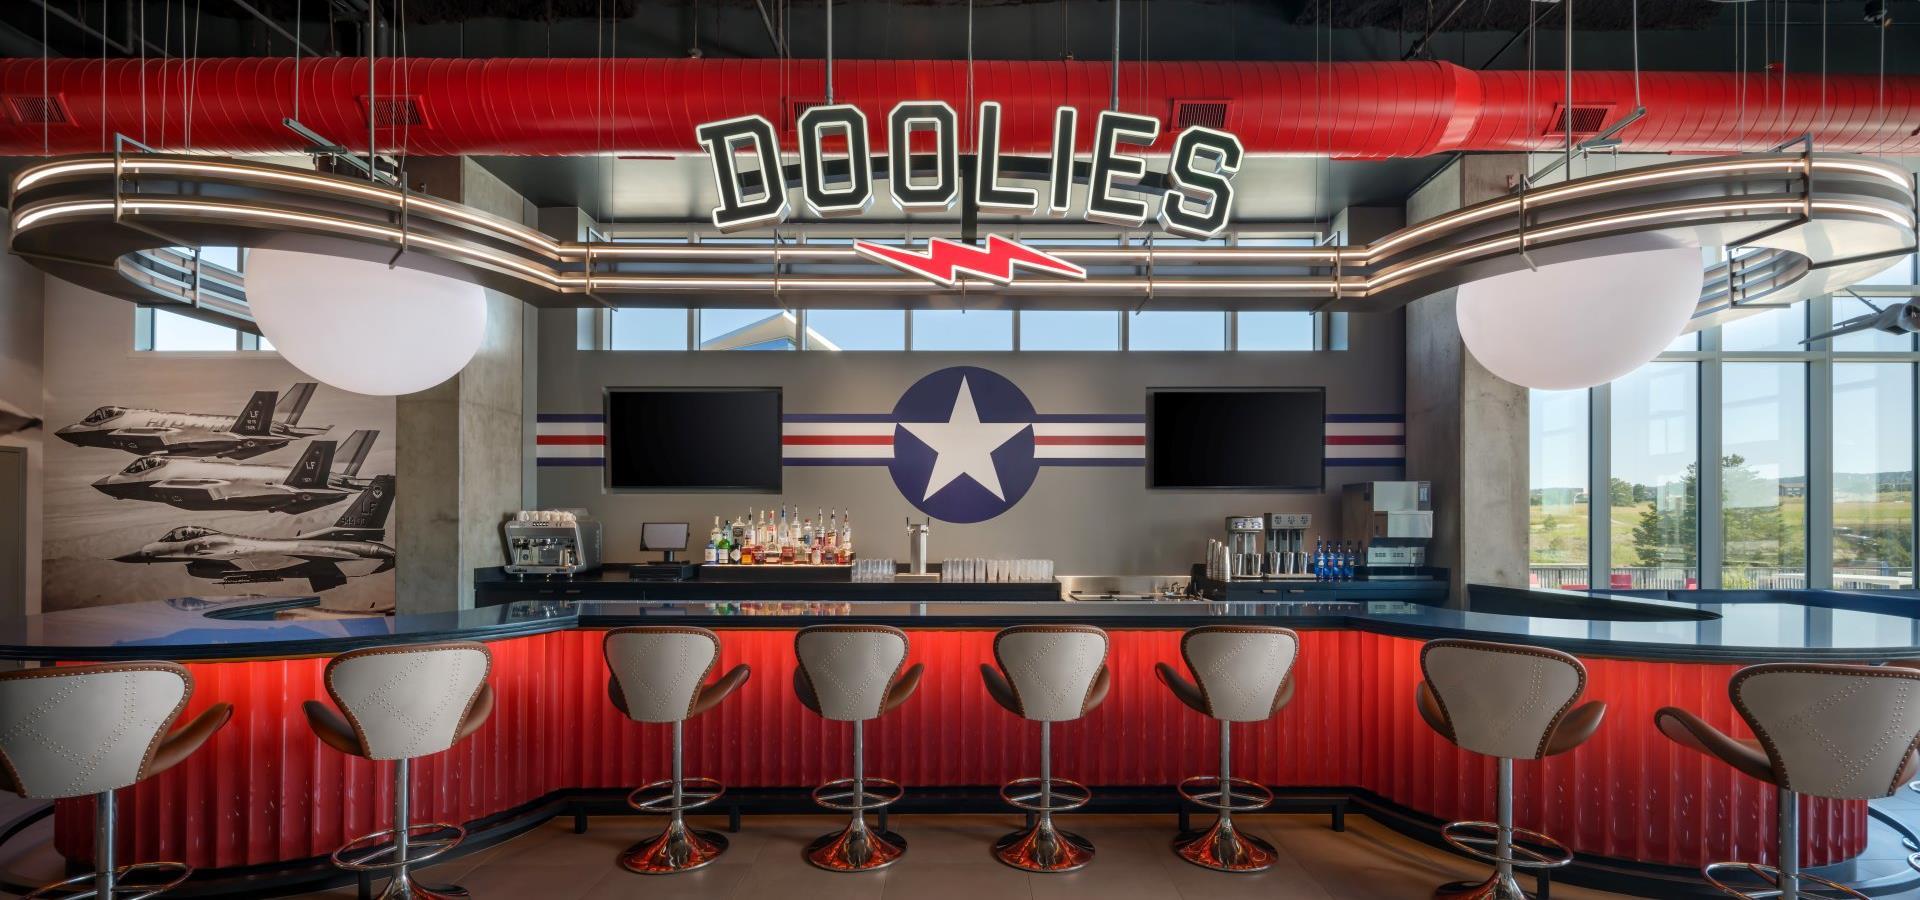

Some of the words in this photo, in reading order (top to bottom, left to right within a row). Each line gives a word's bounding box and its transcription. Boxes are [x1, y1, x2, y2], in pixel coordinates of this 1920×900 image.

[696, 101, 1244, 240] DOOLIES
[249, 410, 259, 418] LF
[305, 461, 315, 470] LF
[361, 502, 377, 516] LF
